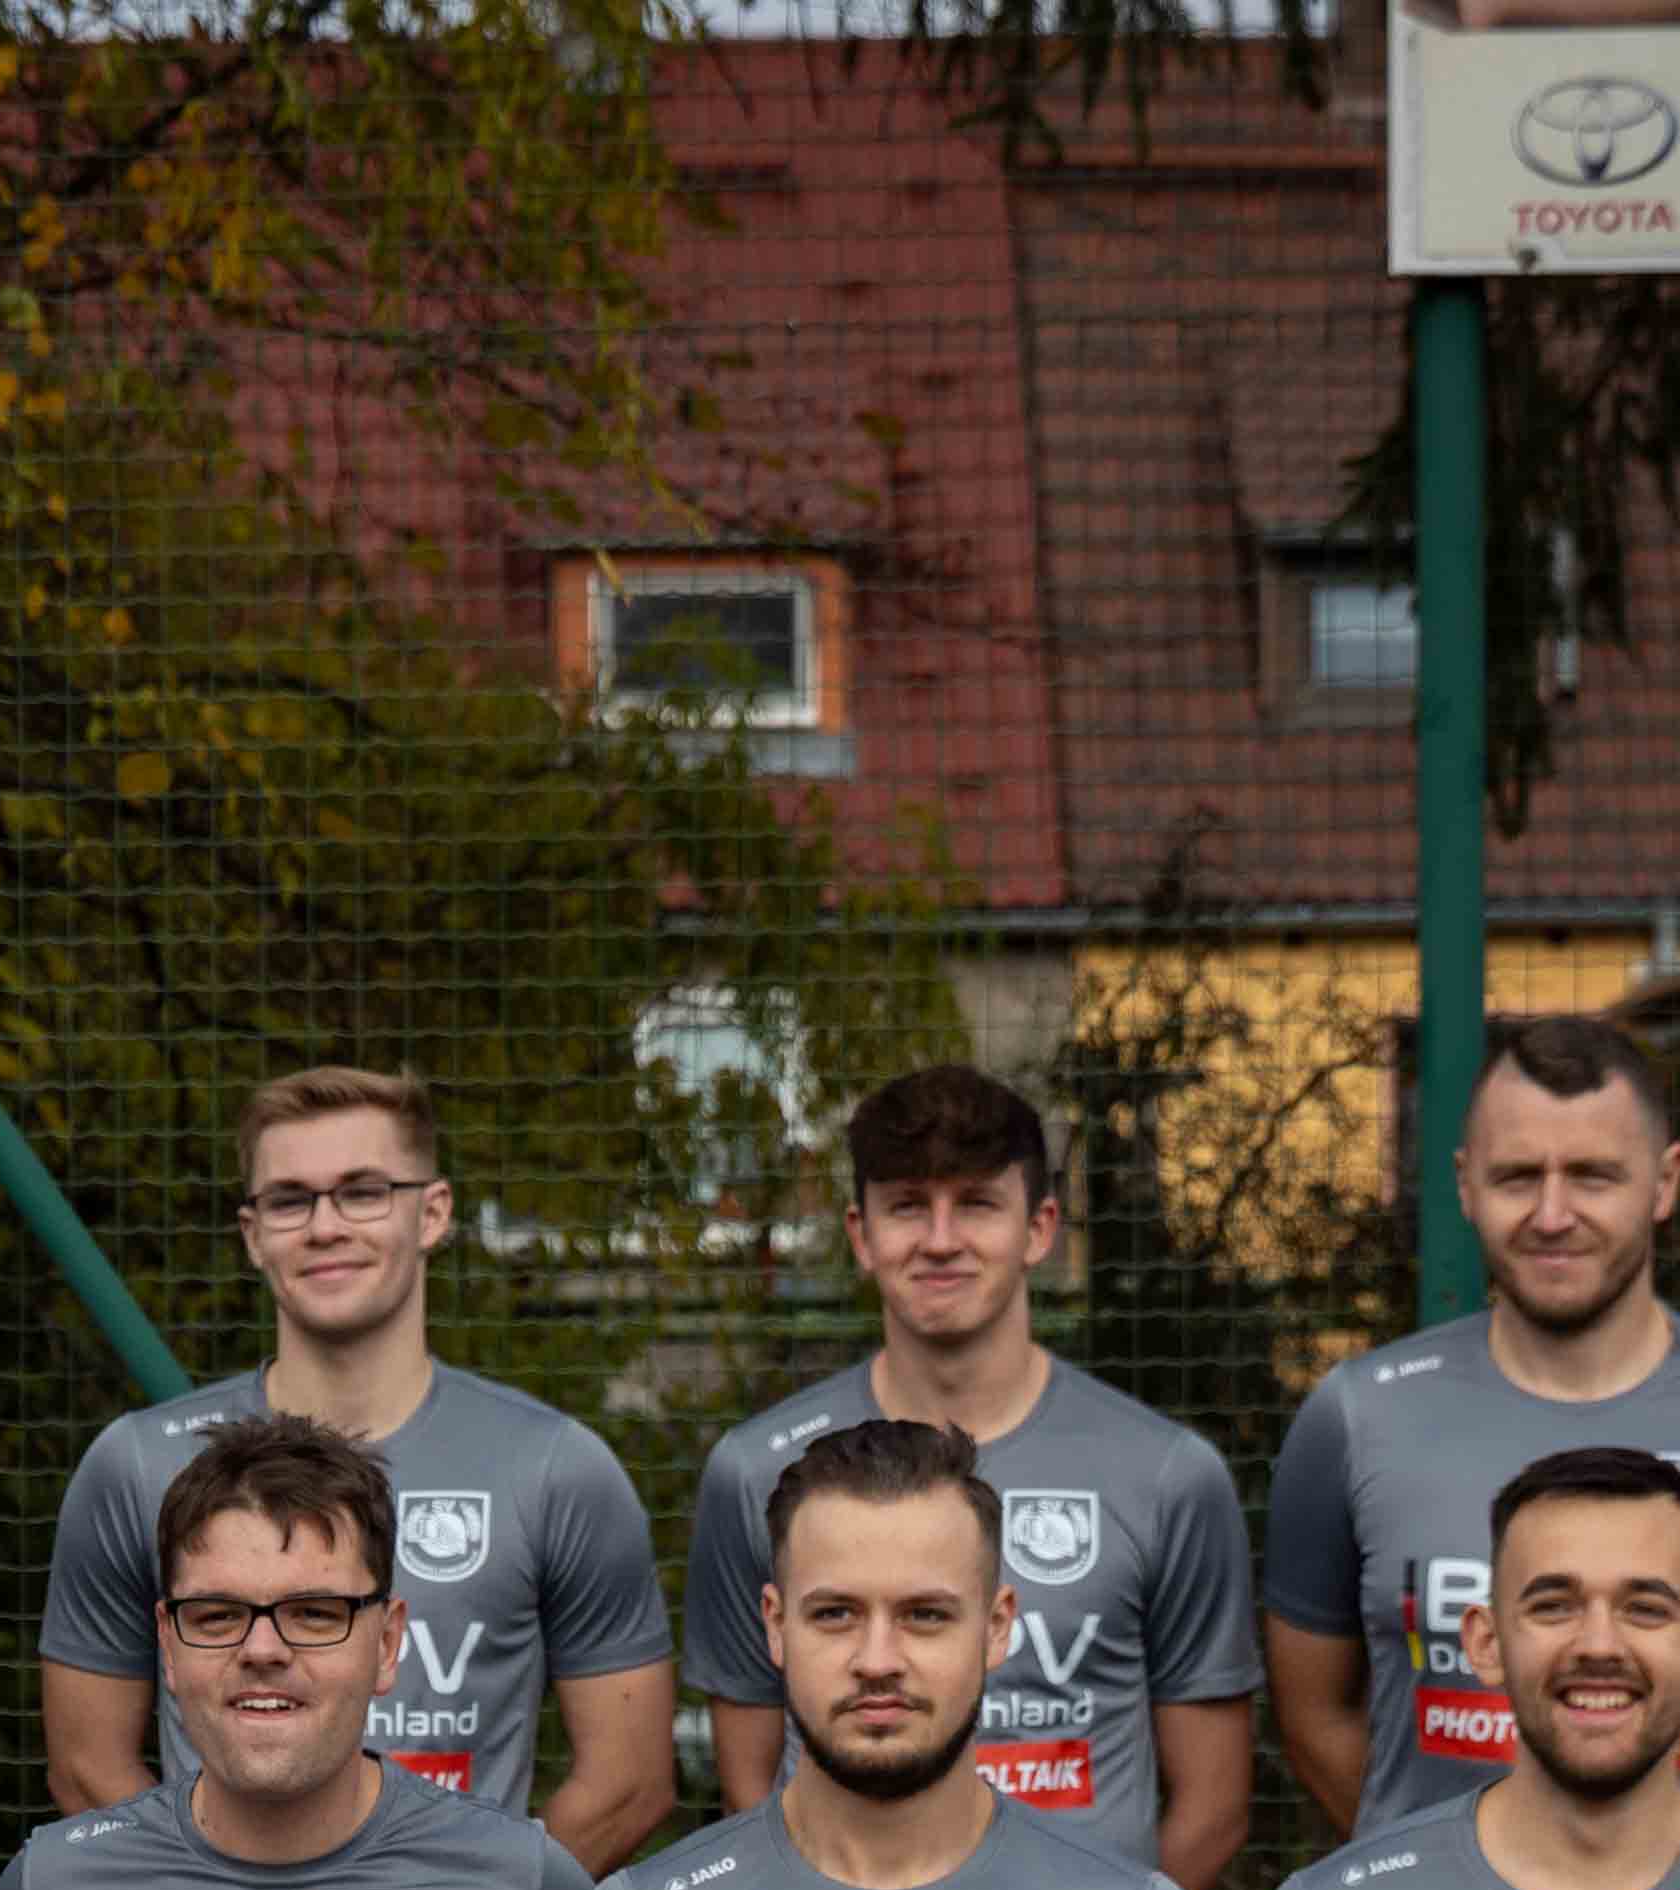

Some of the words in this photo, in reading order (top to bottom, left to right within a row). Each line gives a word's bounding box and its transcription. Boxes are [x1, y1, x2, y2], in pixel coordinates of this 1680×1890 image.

[1511, 202, 1677, 235] TOYOTA
[690, 1857, 736, 1886] JAKO
[1369, 1852, 1417, 1876] JAKO
